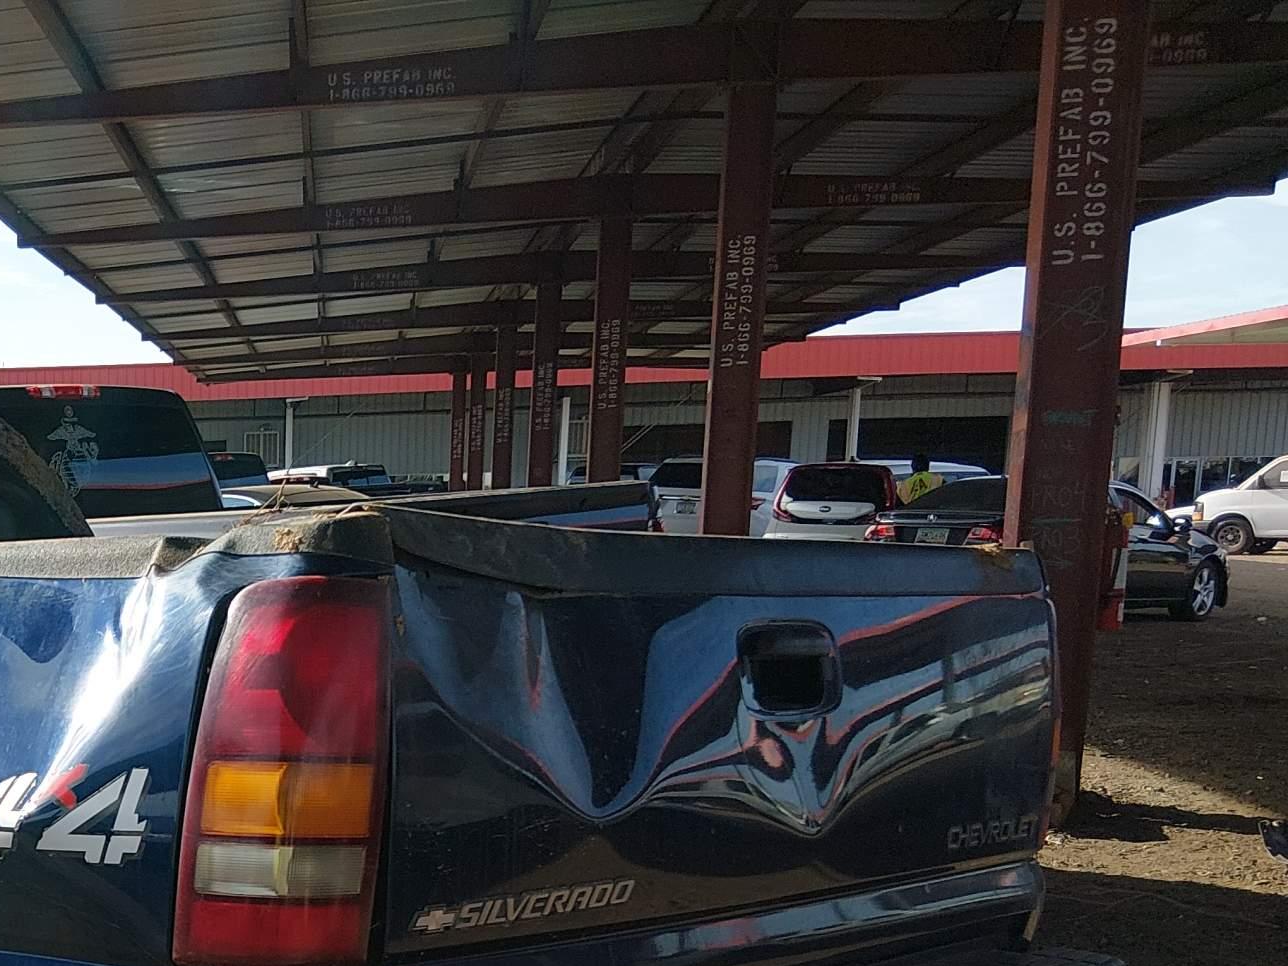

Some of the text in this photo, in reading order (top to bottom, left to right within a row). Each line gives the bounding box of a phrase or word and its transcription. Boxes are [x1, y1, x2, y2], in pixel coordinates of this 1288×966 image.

[1052, 16, 1091, 266] U.S. PREFAB INC.
[1080, 17, 1118, 262] 1-866-799-0969
[720, 234, 742, 367] U.S. PREFAB INC.
[735, 235, 756, 365] 1-866-799-0969
[947, 816, 1039, 849] CHEVROLET
[456, 880, 635, 929] SILVERADO
